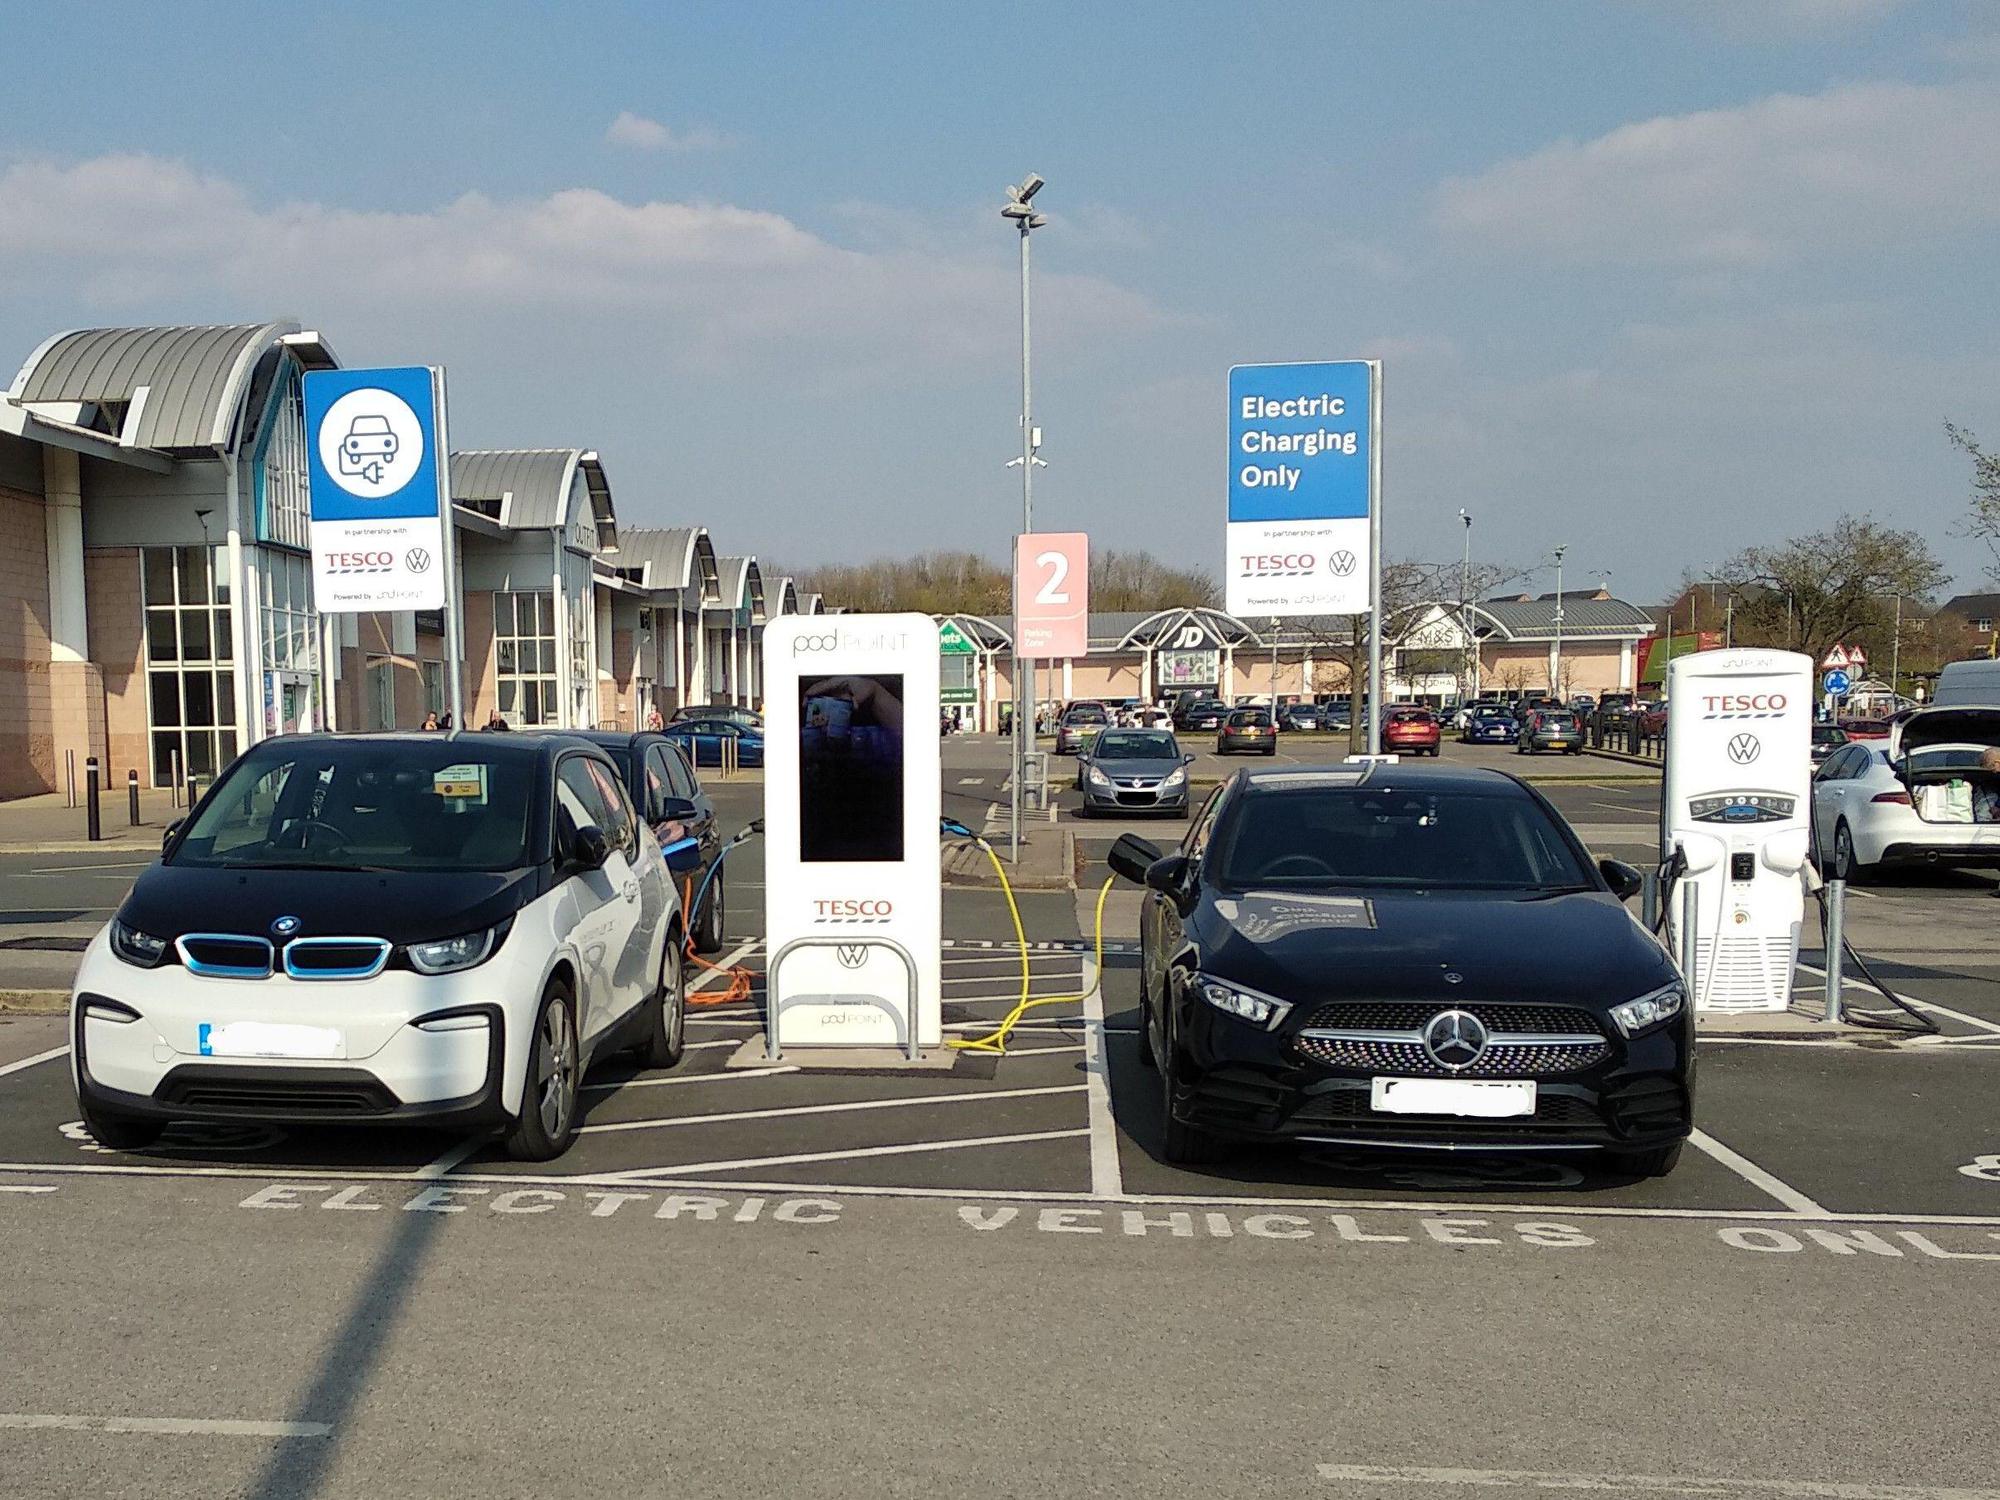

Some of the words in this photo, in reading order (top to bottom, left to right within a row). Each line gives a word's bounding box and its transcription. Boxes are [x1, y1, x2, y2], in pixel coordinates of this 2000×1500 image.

[1242, 394, 1345, 418] Electric
[1241, 428, 1357, 456] Charging
[1241, 464, 1301, 491] Only
[352, 527, 391, 536] partnership
[1272, 529, 1316, 538] partnership
[325, 551, 394, 567] TESCO
[1240, 554, 1316, 570] TESCO
[1034, 550, 1070, 605] 2
[1247, 597, 1279, 605] Powered
[1280, 597, 1289, 605] by
[793, 628, 838, 658] pod
[1172, 626, 1204, 648] JD
[1419, 628, 1454, 643] M&S
[1702, 694, 1787, 712] TESCO
[813, 900, 893, 916] TESCO
[821, 1011, 846, 1027] pod
[238, 1184, 844, 1223] ELECTRIC
[957, 1206, 1598, 1247] VEHICLES
[1717, 1226, 2000, 1261] ONL
